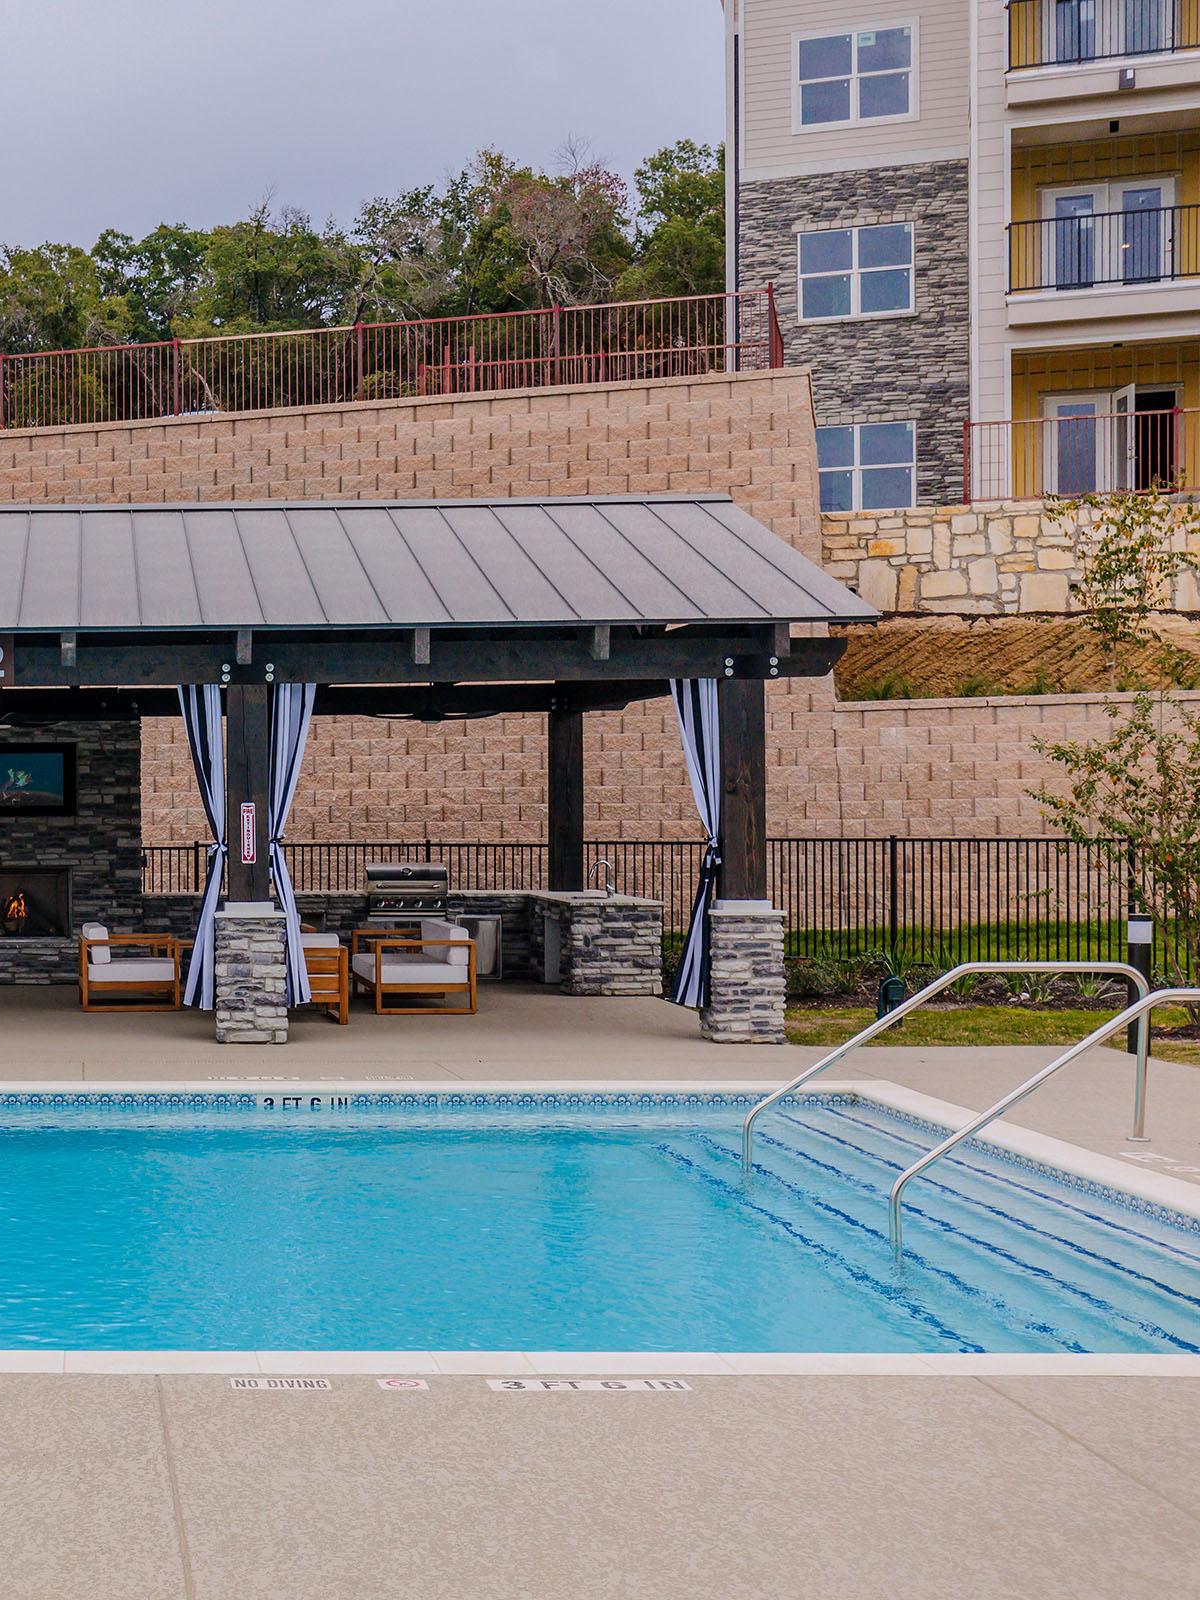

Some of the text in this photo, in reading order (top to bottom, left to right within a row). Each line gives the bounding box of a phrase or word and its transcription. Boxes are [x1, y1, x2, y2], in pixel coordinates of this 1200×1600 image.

[234, 1379, 328, 1389] NO DIVING
[501, 1380, 686, 1390] 3 FT 6 IN
